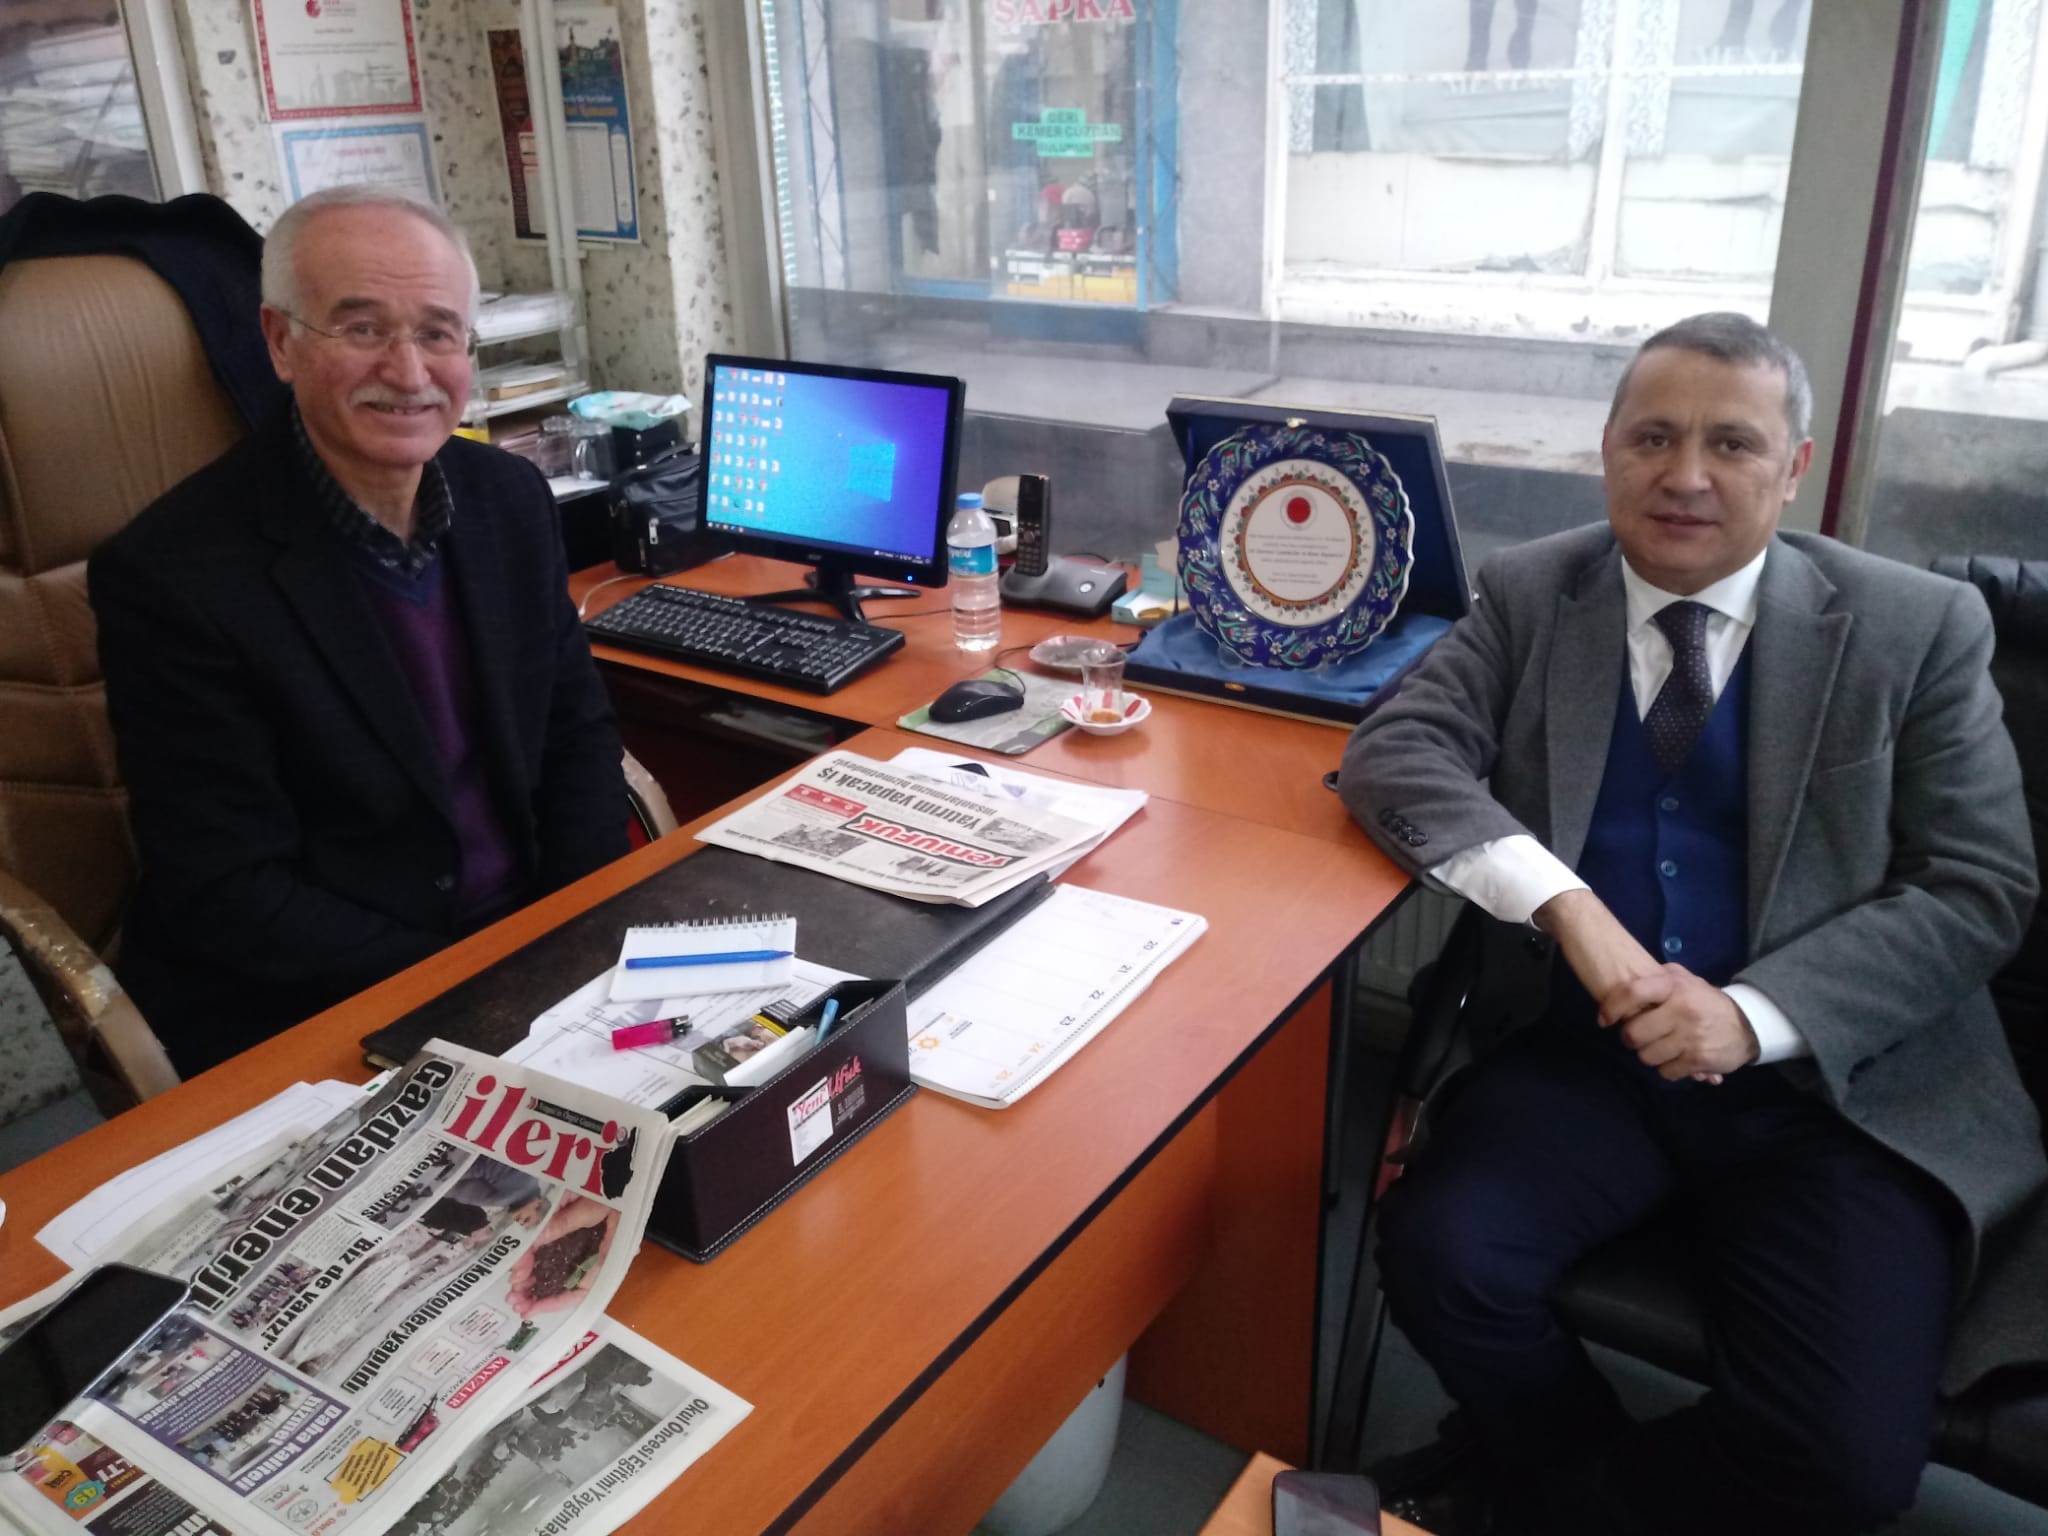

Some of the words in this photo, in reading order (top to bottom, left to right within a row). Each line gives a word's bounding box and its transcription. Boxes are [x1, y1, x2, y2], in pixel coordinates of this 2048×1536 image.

[817, 766, 837, 780] iş
[836, 772, 914, 807] yapacak
[912, 798, 982, 831] Yatırım
[1143, 940, 1158, 951] 20
[1088, 989, 1105, 1000] 22
[1059, 1015, 1076, 1026] 23
[308, 1059, 455, 1191] Gazdan
[443, 1075, 618, 1197] ileri
[408, 1140, 457, 1180] Erken
[191, 1187, 323, 1314] enerji
[478, 1235, 521, 1269] Son
[314, 1264, 344, 1290] de
[399, 1262, 493, 1337] kontroller
[340, 1328, 412, 1395] yapıldı
[268, 1393, 324, 1447] hizmet
[296, 1404, 343, 1445] Daha
[677, 1397, 710, 1432] Okul
[640, 1421, 689, 1462] Öncesi
[235, 1439, 303, 1492] kaliteli
[595, 1453, 647, 1494] Eğitimi
